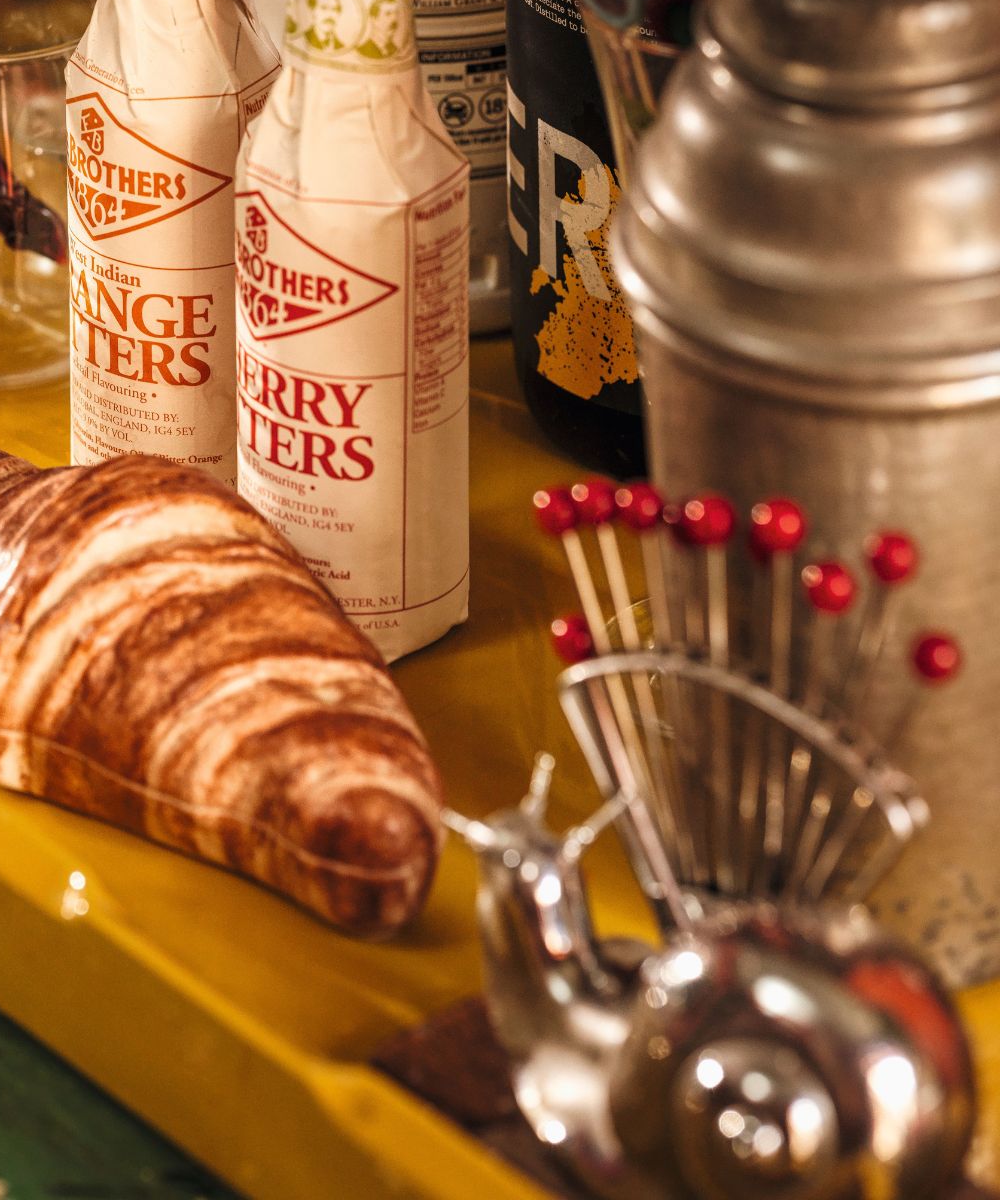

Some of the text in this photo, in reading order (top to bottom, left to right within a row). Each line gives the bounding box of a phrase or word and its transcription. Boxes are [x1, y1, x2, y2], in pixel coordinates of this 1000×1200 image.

[535, 2, 567, 27] Distilled
[569, 21, 578, 31] to
[69, 133, 186, 200] BROTHERS
[90, 255, 142, 288] Indian
[236, 230, 350, 306] ROTHERS
[92, 370, 147, 404] Flavouring
[93, 393, 160, 421] DISTRIBUTED
[163, 413, 179, 423] BY:
[99, 423, 111, 434] BY
[101, 411, 150, 434] ENGLAND,
[154, 426, 173, 436] IG4
[176, 426, 196, 437] 5EY
[188, 454, 223, 465] Orange
[312, 518, 331, 531] IG4
[335, 520, 355, 532] 5EY
[328, 569, 350, 580] Acid
[379, 595, 401, 607] N.Y.
[363, 620, 373, 630] of
